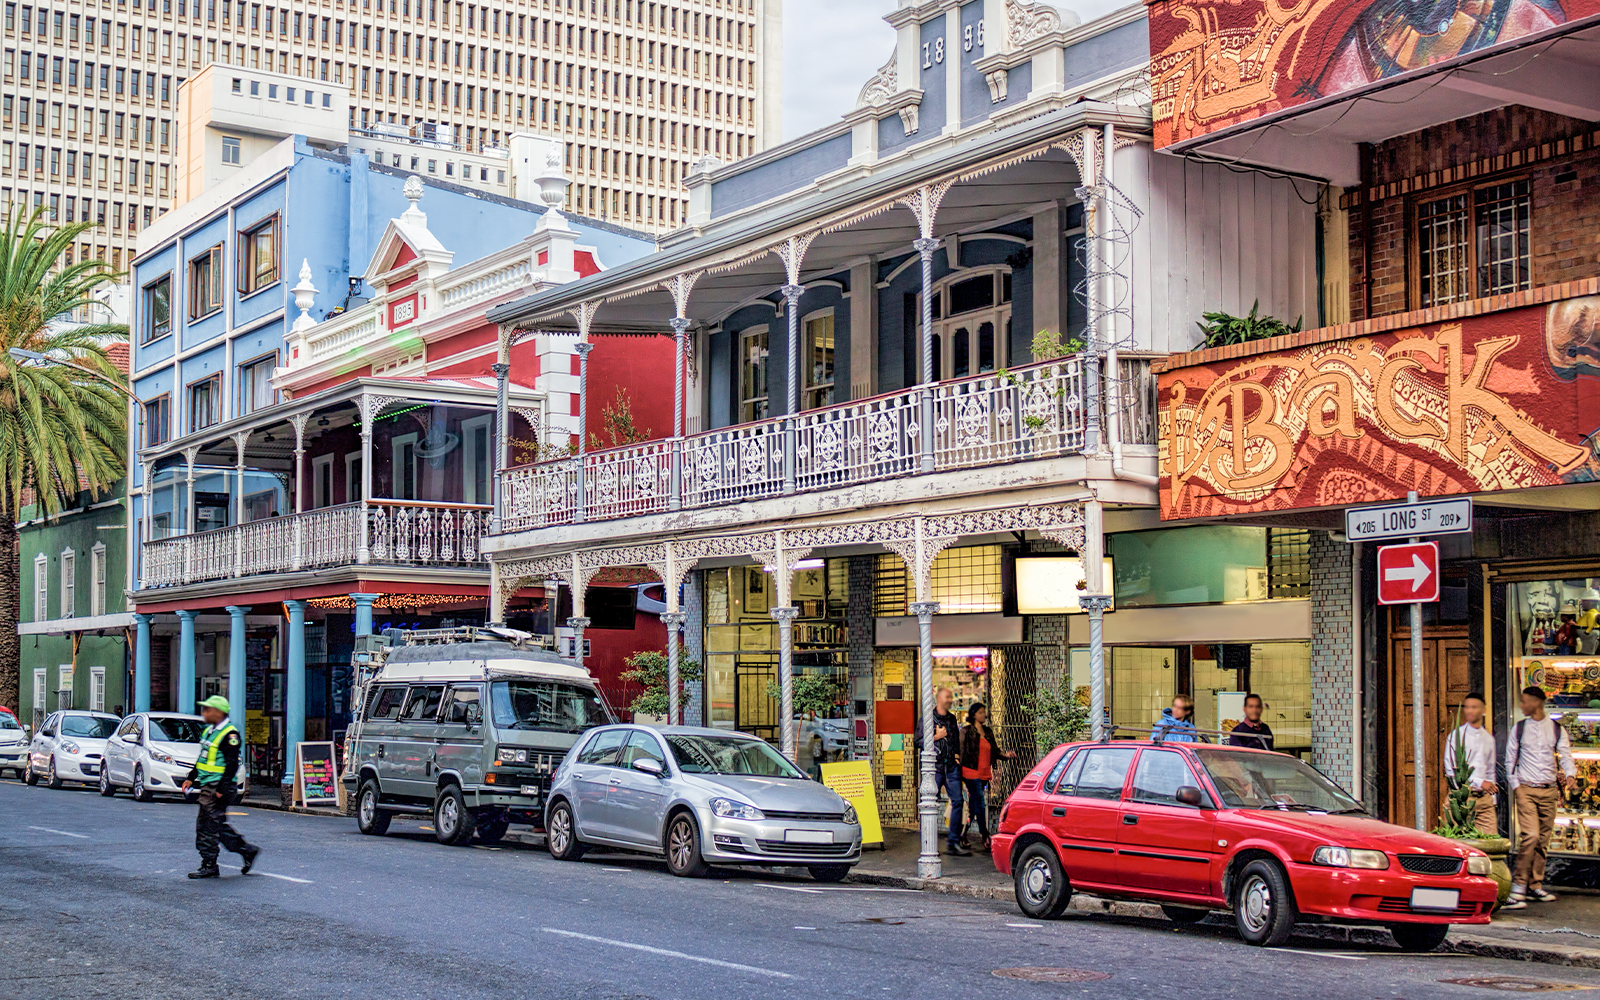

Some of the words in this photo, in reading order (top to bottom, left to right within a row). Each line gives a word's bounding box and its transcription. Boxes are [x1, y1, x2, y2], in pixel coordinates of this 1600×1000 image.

[395, 304, 412, 320] 1895
[1362, 521, 1376, 533] 205
[1382, 510, 1416, 532] LONG
[1421, 508, 1432, 521] ST
[1440, 513, 1455, 527] 209
